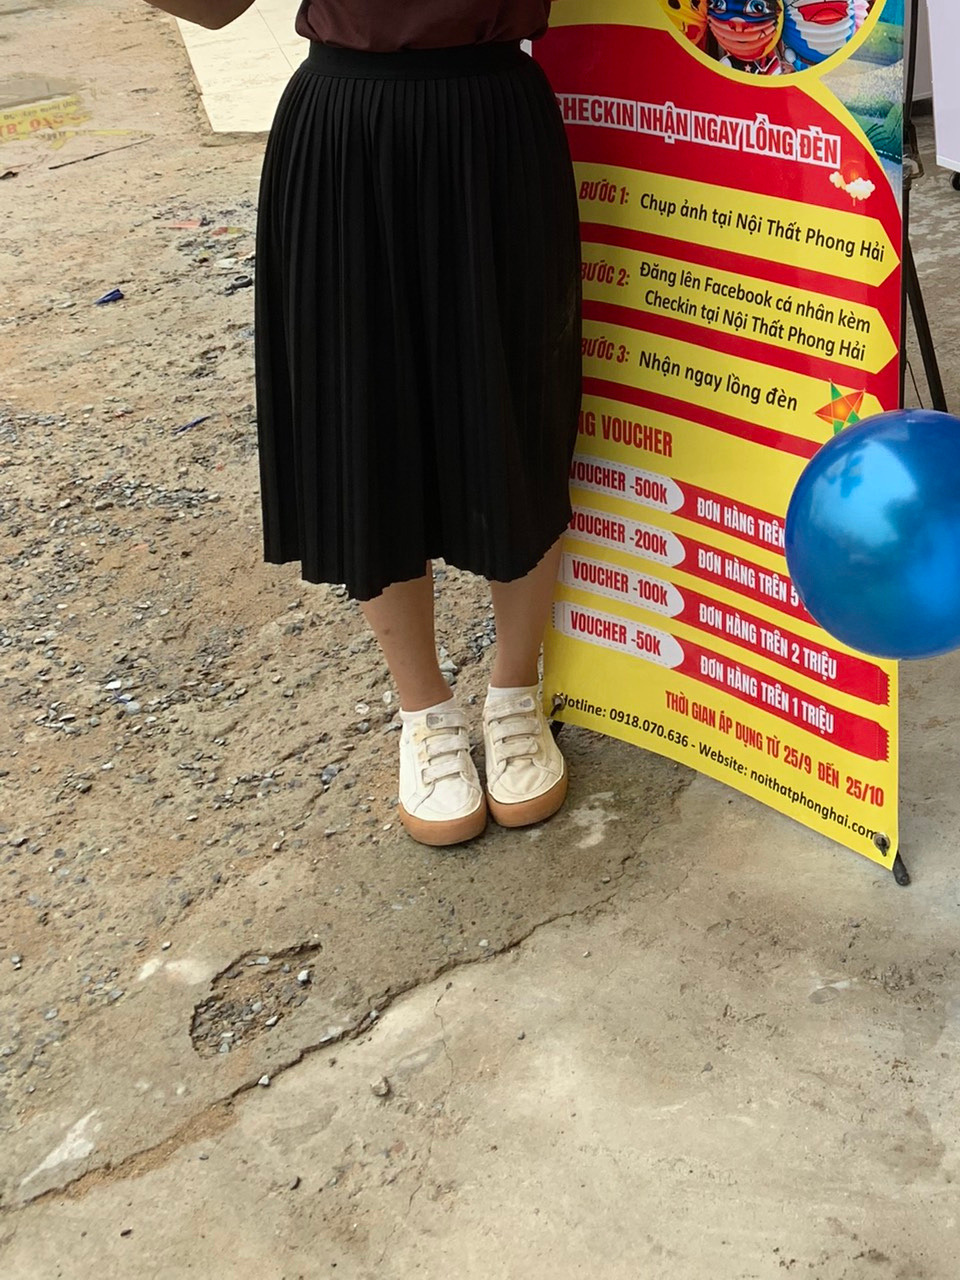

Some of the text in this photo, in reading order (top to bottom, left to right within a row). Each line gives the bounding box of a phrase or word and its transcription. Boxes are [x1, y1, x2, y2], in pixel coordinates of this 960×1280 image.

[557, 96, 838, 165] HECKIN NHẬN NGAY LỒNG ĐÈN
[579, 179, 885, 262] BƯỚC 1: Chụp ảnh tại Nội Thất Phong Hải
[616, 268, 630, 286] 2:
[640, 261, 871, 333] Đăng lên Facebook cá nhân kèm
[645, 290, 866, 361] Checkin tại Nội Thất Phong Hải
[616, 345, 630, 363] 3:
[639, 351, 680, 377] Nhận
[685, 366, 722, 392] ngay
[726, 373, 761, 404] lồng
[766, 387, 798, 411] đèn
[601, 414, 673, 458] VOUCHER
[569, 511, 625, 543] VOUCHER
[697, 496, 786, 548] ĐƠN HÀNG TRÊN
[572, 559, 628, 593] VOUCHER
[698, 548, 799, 607] ĐƠN HÀNG TRÊN 5
[570, 610, 627, 645] VOUCHER
[699, 602, 837, 681] ĐƠN HÀNG TRÊN 2 TRIỆU
[700, 655, 834, 735] ĐƠN HÀNG TRÊN 1 TRIỆU
[609, 708, 688, 748] 0918.070.636
[699, 741, 748, 776] Website:
[750, 769, 877, 840] noithatphonghai.com
[665, 690, 885, 808] THỜI GIAN ÁP DỤNG TỪ 25/9 ĐẾN 25/10
